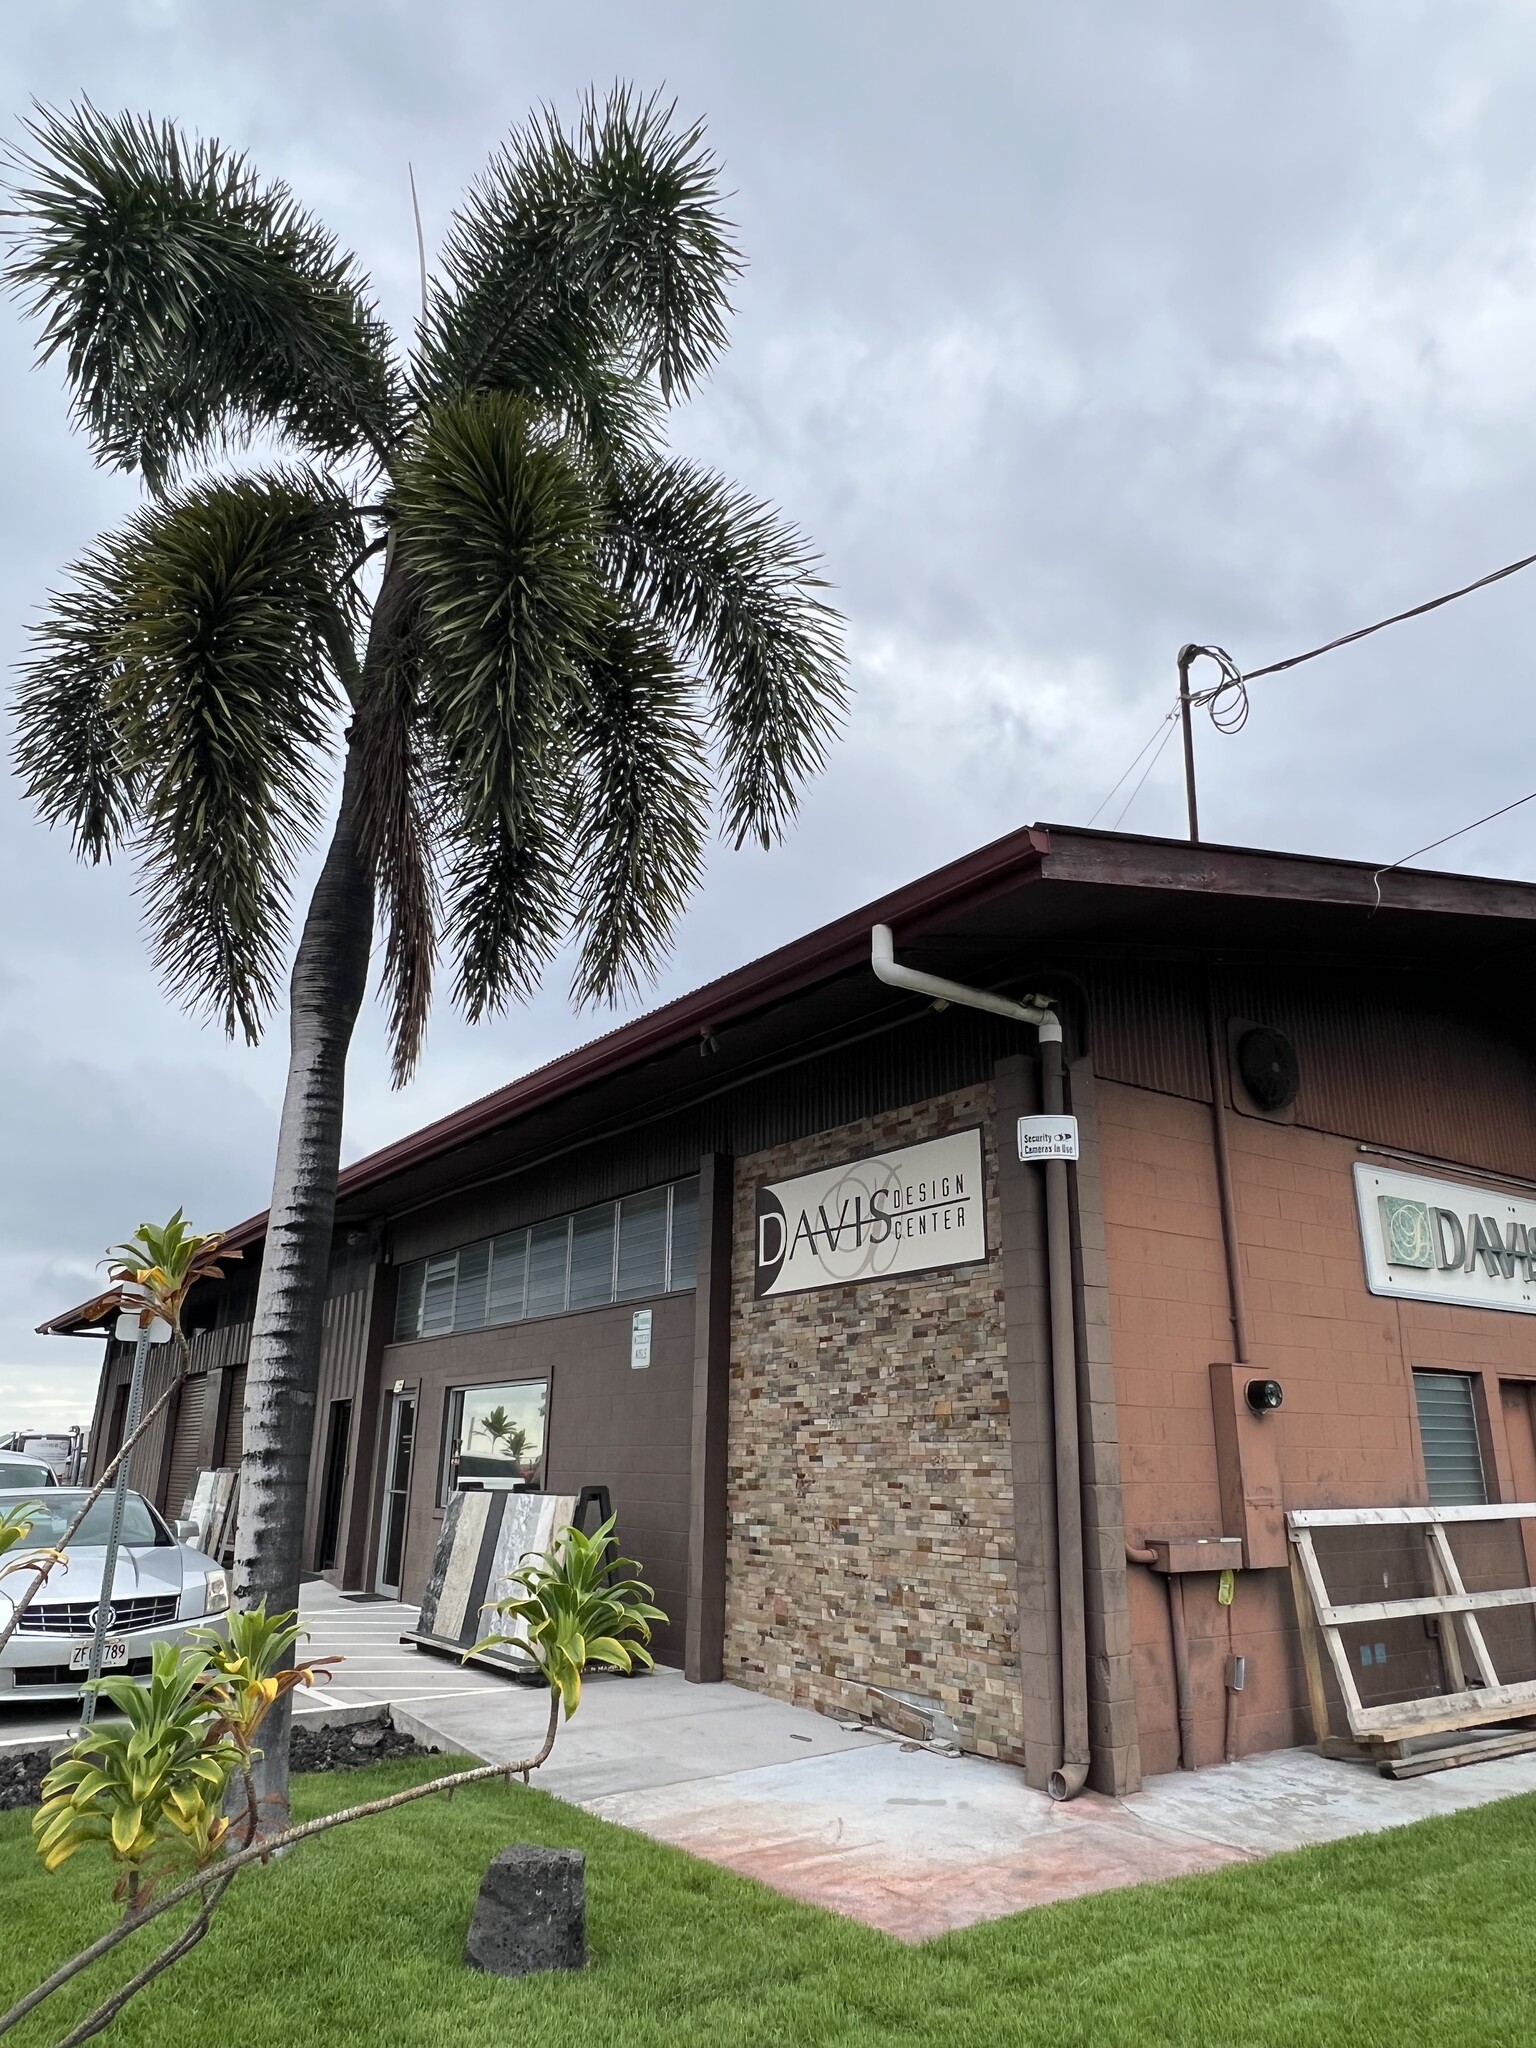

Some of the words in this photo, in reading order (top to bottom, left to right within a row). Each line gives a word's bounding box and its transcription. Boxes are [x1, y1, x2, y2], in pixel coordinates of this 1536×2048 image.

[1024, 1133, 1052, 1144] Security
[1024, 1145, 1052, 1154] Cameras
[1053, 1144, 1061, 1153] In
[1062, 1144, 1073, 1153] Use
[893, 1173, 964, 1209] DESIGN
[758, 1188, 892, 1267] DAVIS
[894, 1207, 965, 1240] CENTER
[104, 1644, 126, 1660] 789
